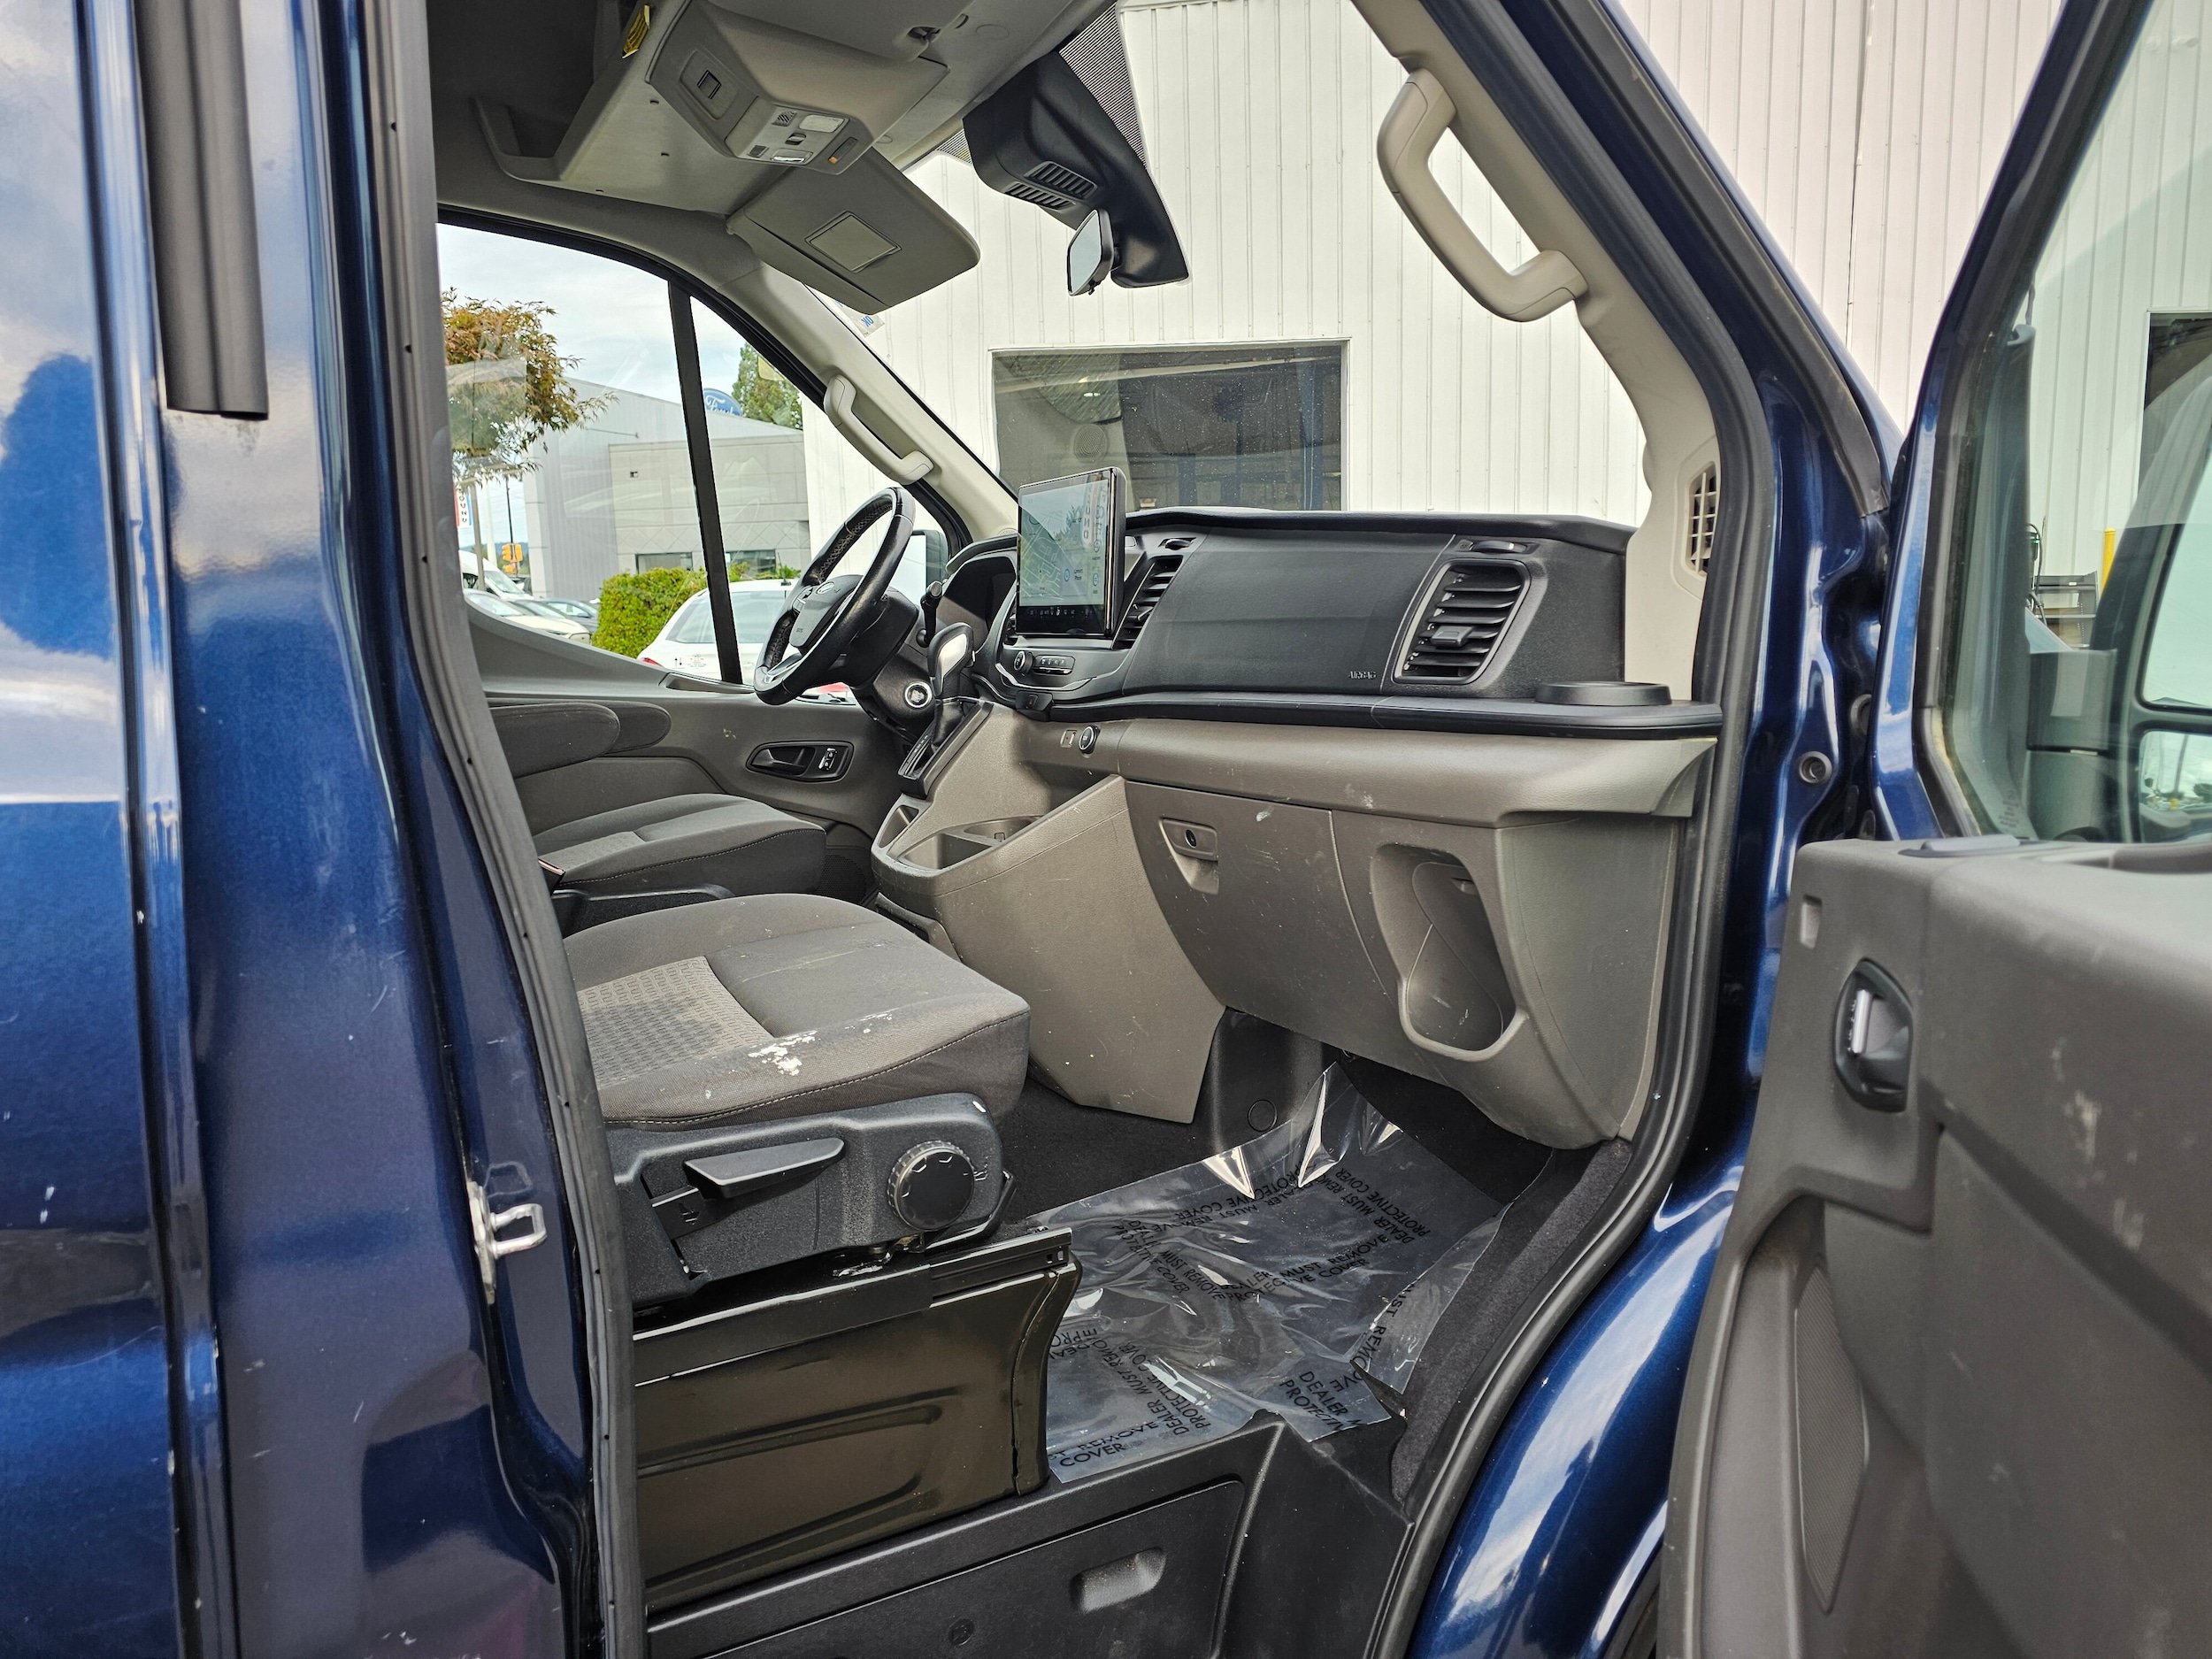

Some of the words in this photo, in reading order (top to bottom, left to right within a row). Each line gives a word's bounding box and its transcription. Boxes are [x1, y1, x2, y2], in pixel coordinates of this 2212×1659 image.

[1335, 1167, 1371, 1194] COVER
[1175, 1202, 1223, 1221] COVER
[1220, 1203, 1258, 1220] MUST
[1340, 1193, 1375, 1217] MUST
[1368, 1191, 1431, 1238] PROTECTIVE
[1374, 1215, 1415, 1245] DEALER
[1280, 1262, 1322, 1279] MUST
[1329, 1233, 1389, 1265] REMOVE
[1318, 1257, 1371, 1279] COVER
[1156, 1266, 1190, 1294] COVER
[1159, 1249, 1188, 1273] MUST
[1183, 1264, 1226, 1301] REMOVE
[1117, 1370, 1152, 1395] MUST
[1299, 1371, 1348, 1416] DEALER
[1148, 1373, 1211, 1429] PROTECTIVE
[1147, 1399, 1190, 1435] DEALER
[1078, 1420, 1159, 1451] REMOVE
[1059, 1442, 1126, 1468] COVER
